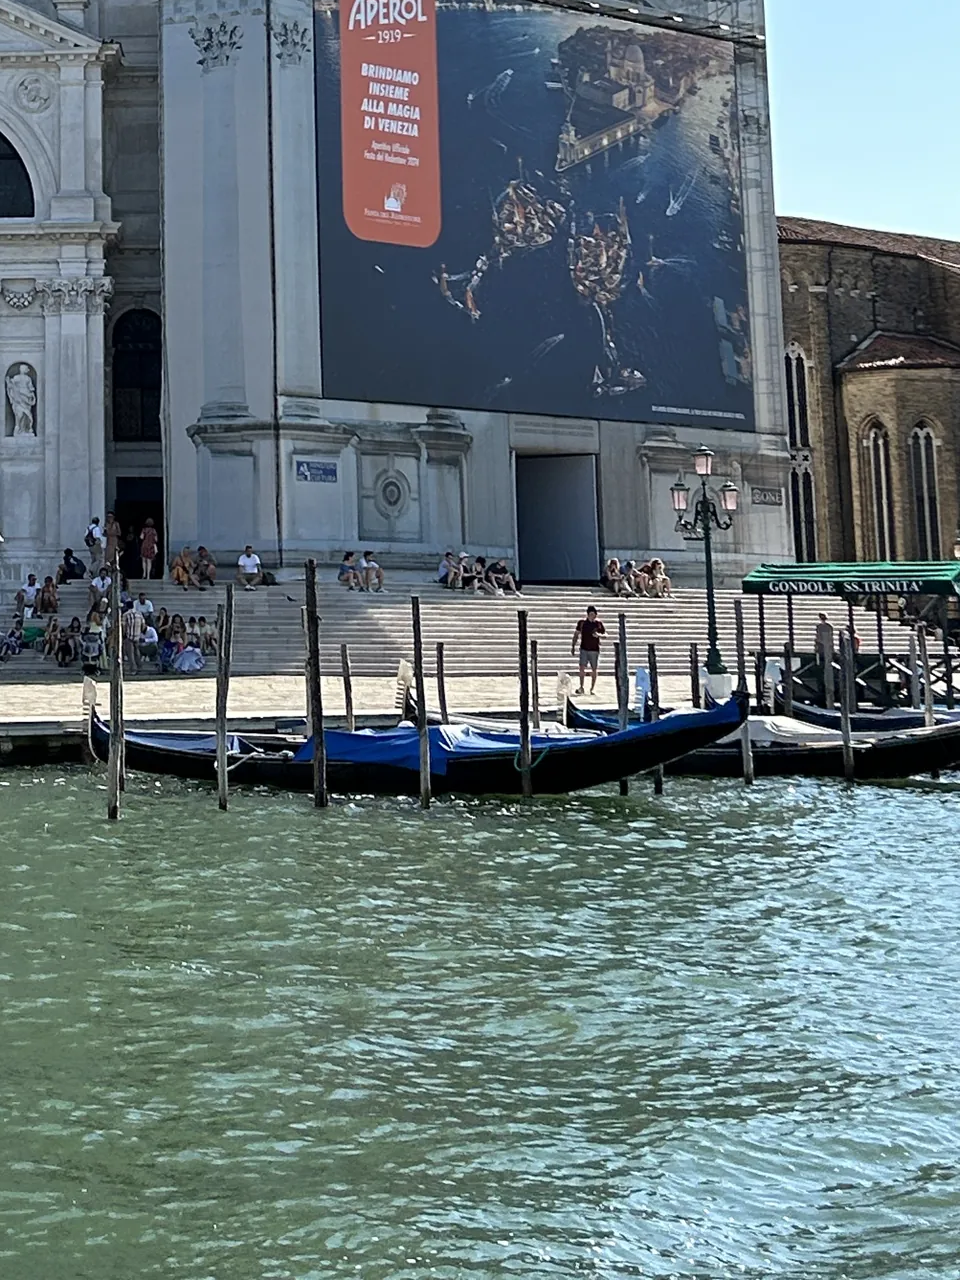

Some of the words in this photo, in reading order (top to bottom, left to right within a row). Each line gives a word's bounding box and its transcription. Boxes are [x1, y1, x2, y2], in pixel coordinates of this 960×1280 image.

[377, 29, 402, 44] 1919
[361, 63, 420, 86] BRINDIAMO
[368, 81, 410, 101] INSIEME
[360, 98, 385, 114] ALLA
[387, 102, 421, 121] MAGIA
[363, 115, 376, 130] DI
[378, 118, 419, 137] VENEZIA
[769, 580, 837, 593] GONDOLE
